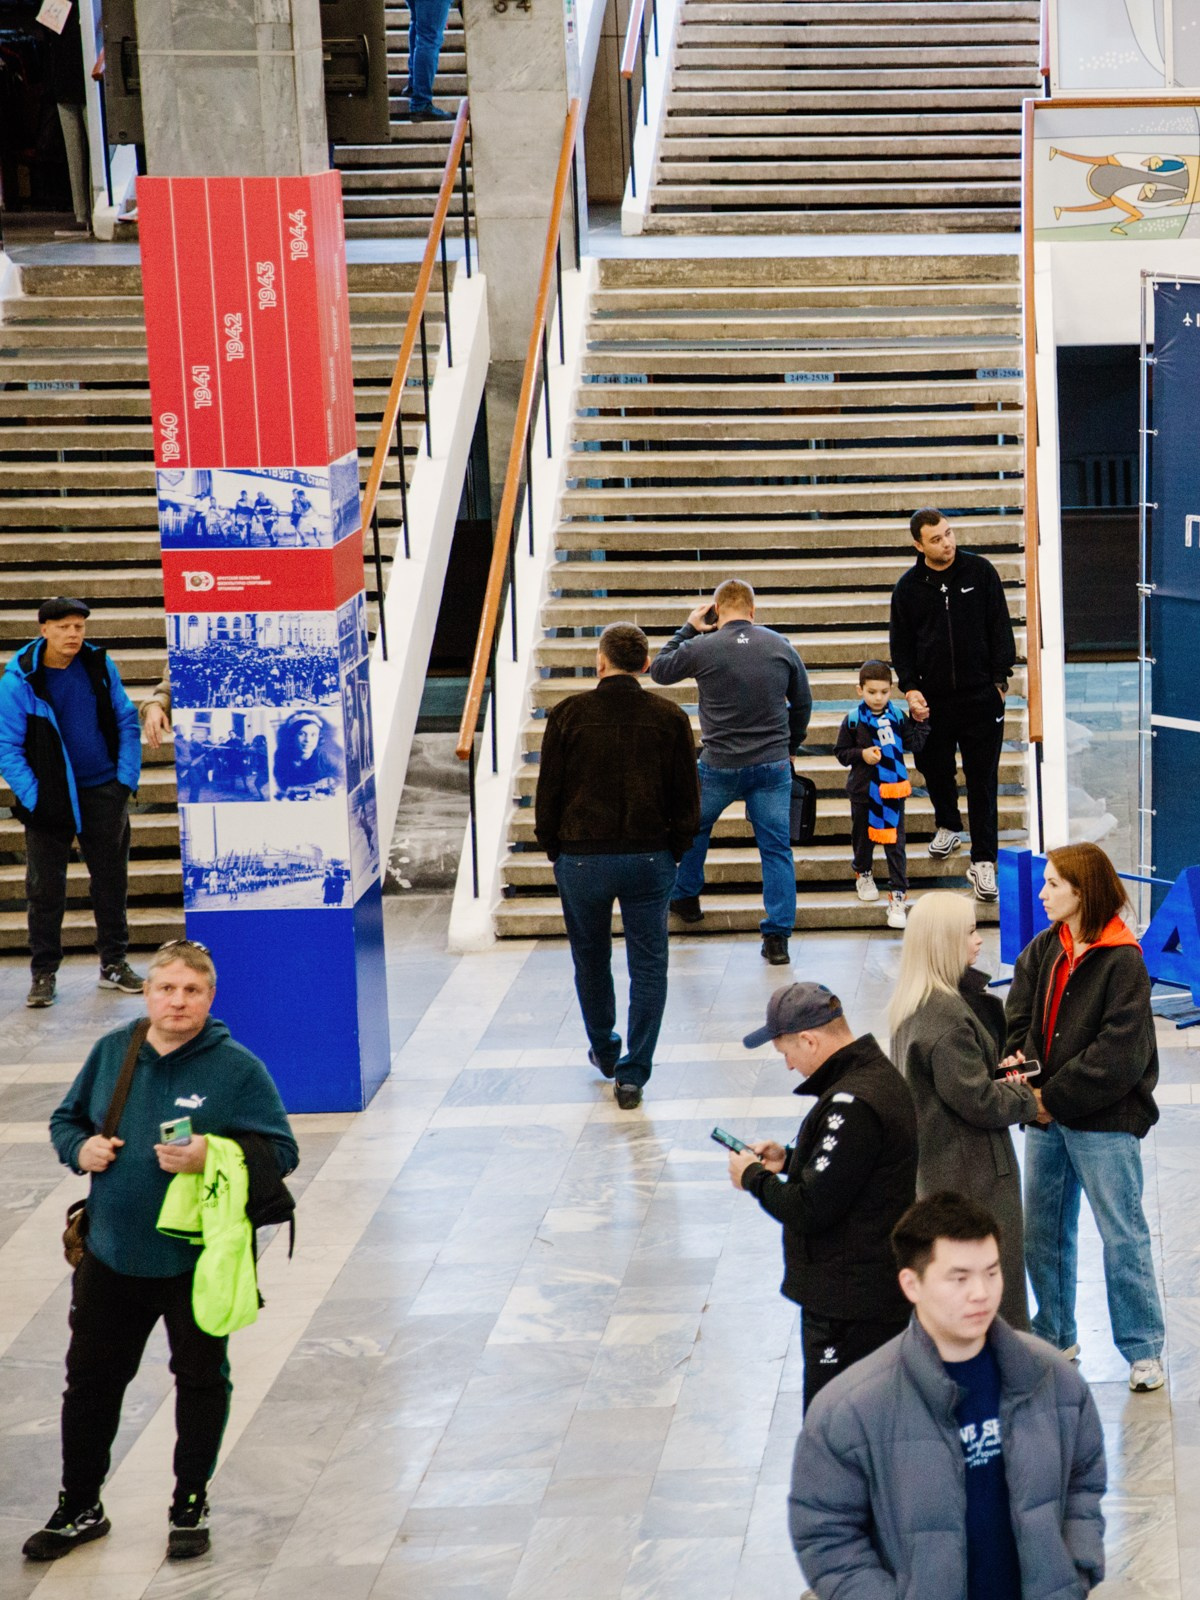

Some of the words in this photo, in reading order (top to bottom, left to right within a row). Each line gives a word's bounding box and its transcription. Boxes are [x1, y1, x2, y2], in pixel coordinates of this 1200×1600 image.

[288, 208, 309, 261] 1944
[256, 260, 277, 310] 1943
[223, 312, 245, 362] 1942
[191, 365, 212, 409] 1941
[159, 411, 180, 463] 1940
